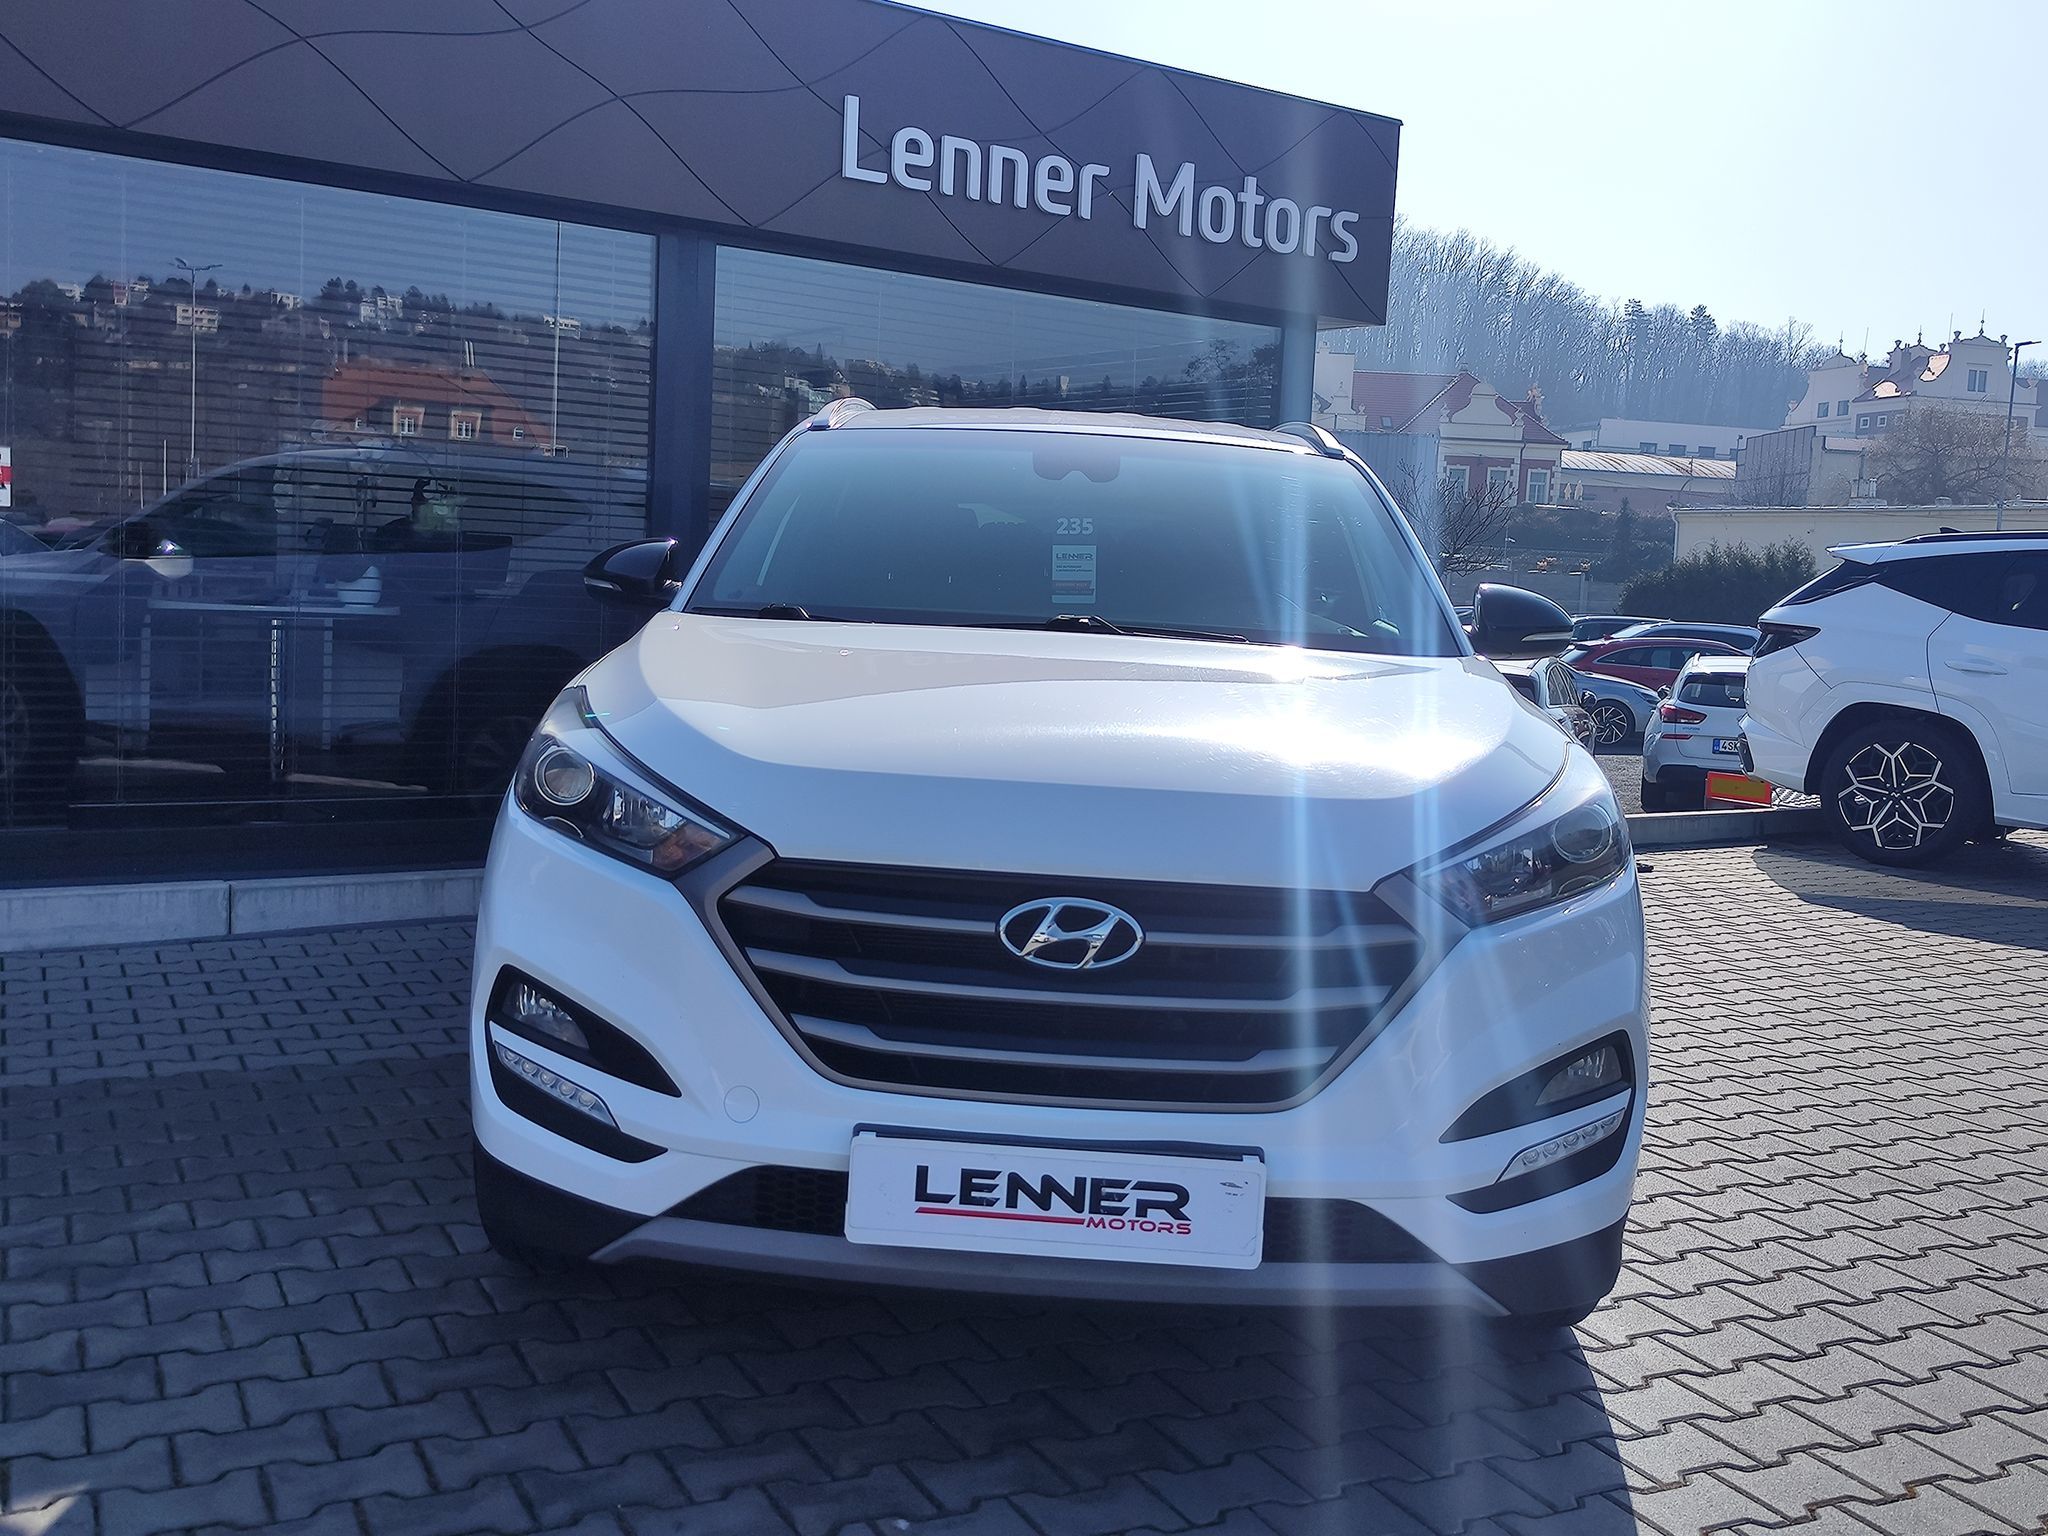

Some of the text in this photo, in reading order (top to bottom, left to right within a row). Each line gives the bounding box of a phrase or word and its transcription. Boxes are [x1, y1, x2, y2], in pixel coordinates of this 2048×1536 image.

[842, 94, 1360, 263] Lenner Motors
[1056, 517, 1094, 535] 235
[914, 1164, 1192, 1222] LENNER
[1085, 1216, 1192, 1235] MOTORS
